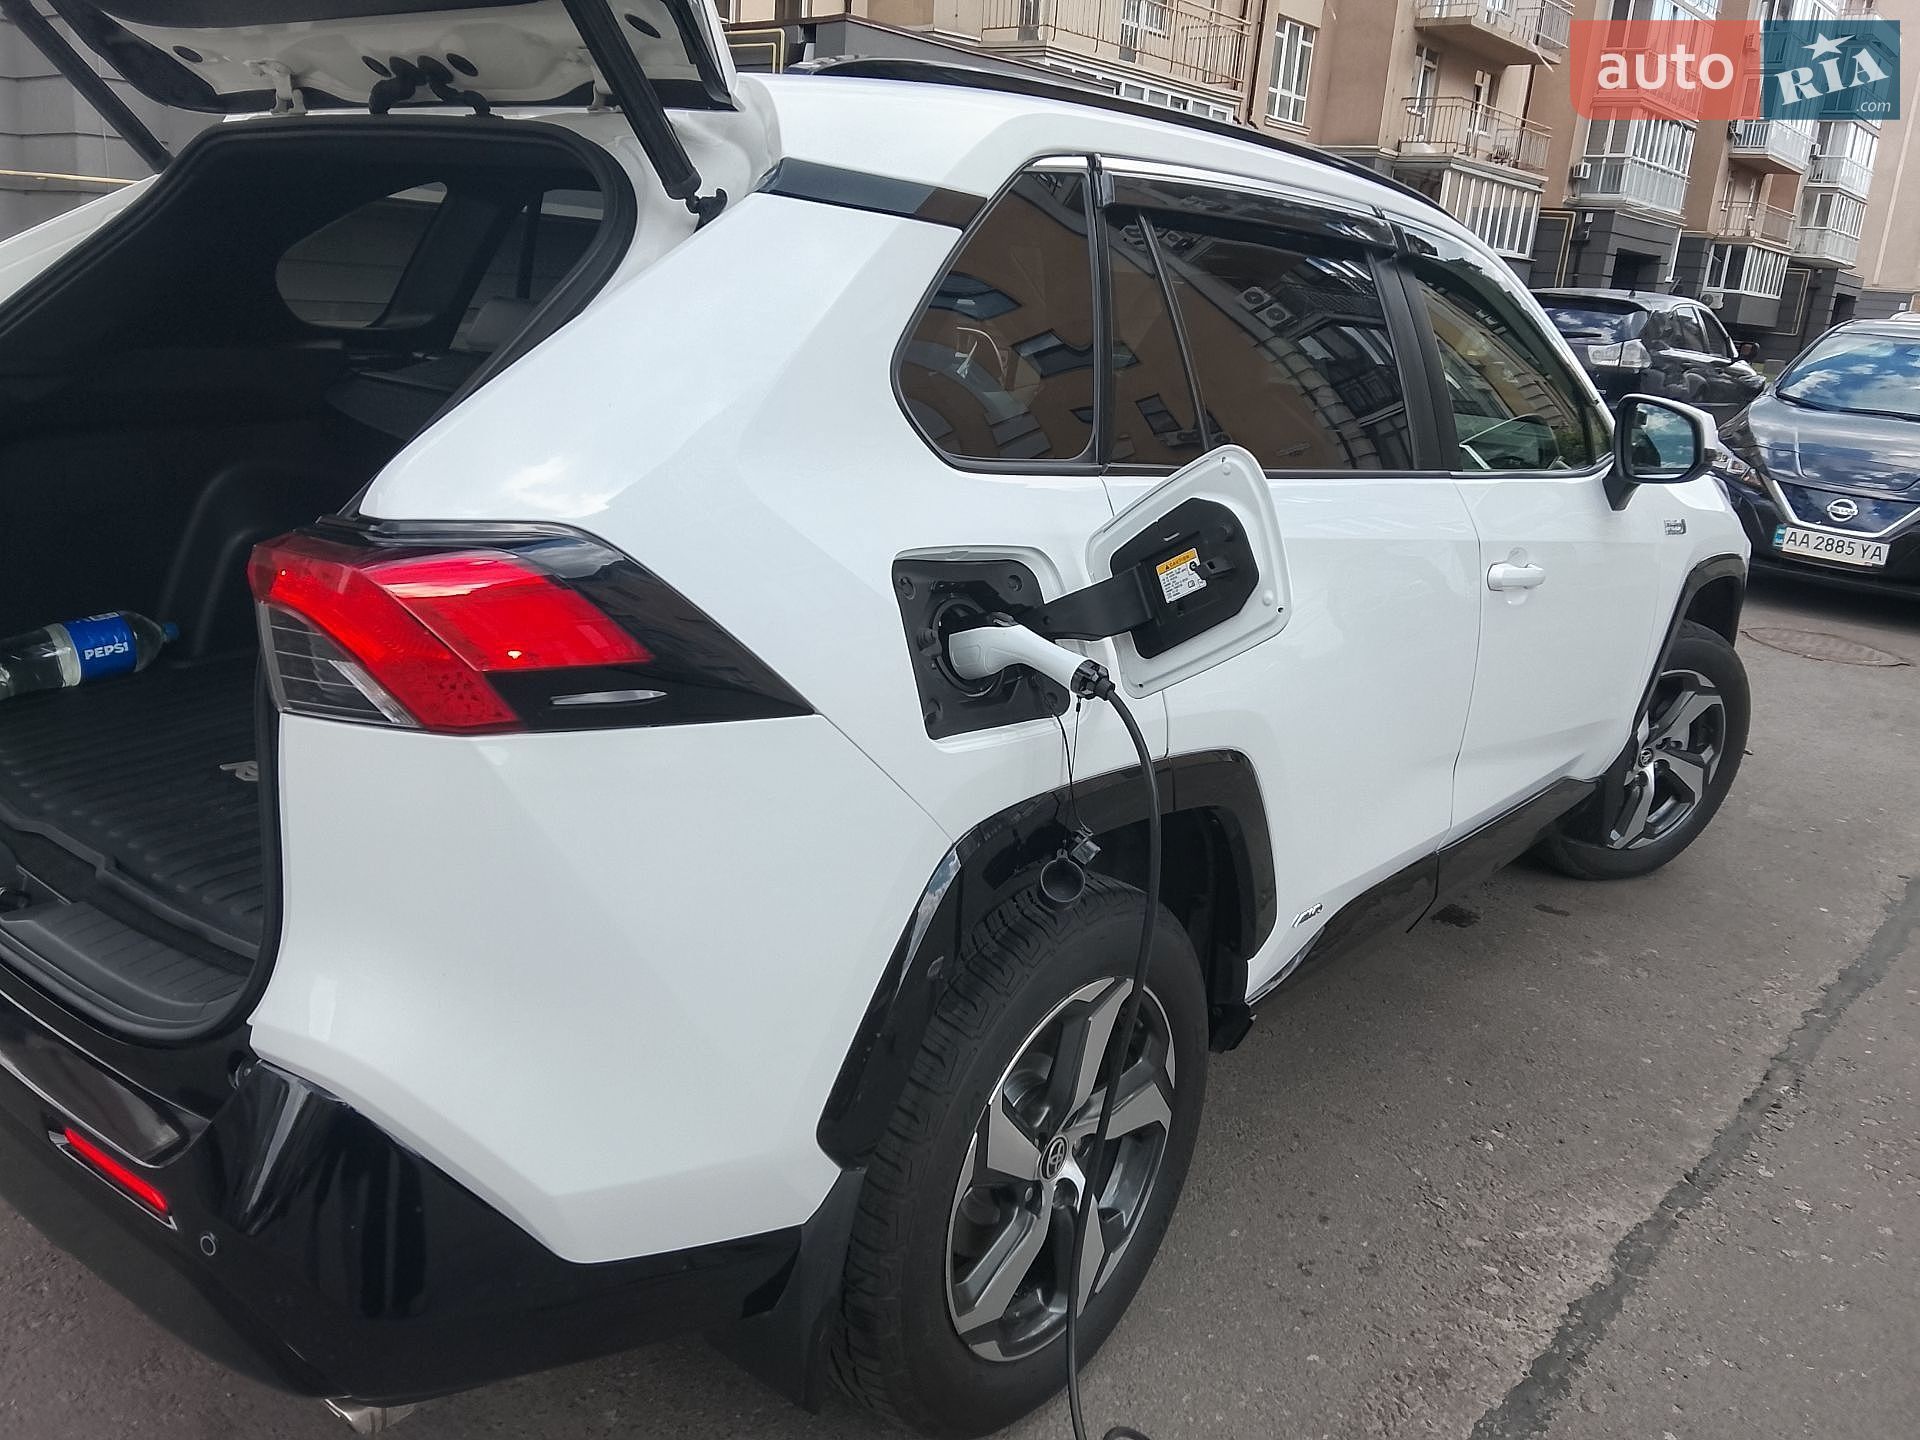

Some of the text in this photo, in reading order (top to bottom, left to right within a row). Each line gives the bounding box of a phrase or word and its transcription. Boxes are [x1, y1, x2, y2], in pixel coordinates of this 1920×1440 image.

[1786, 531, 1882, 561] AA 2885 YA
[84, 641, 129, 660] PEPSI
